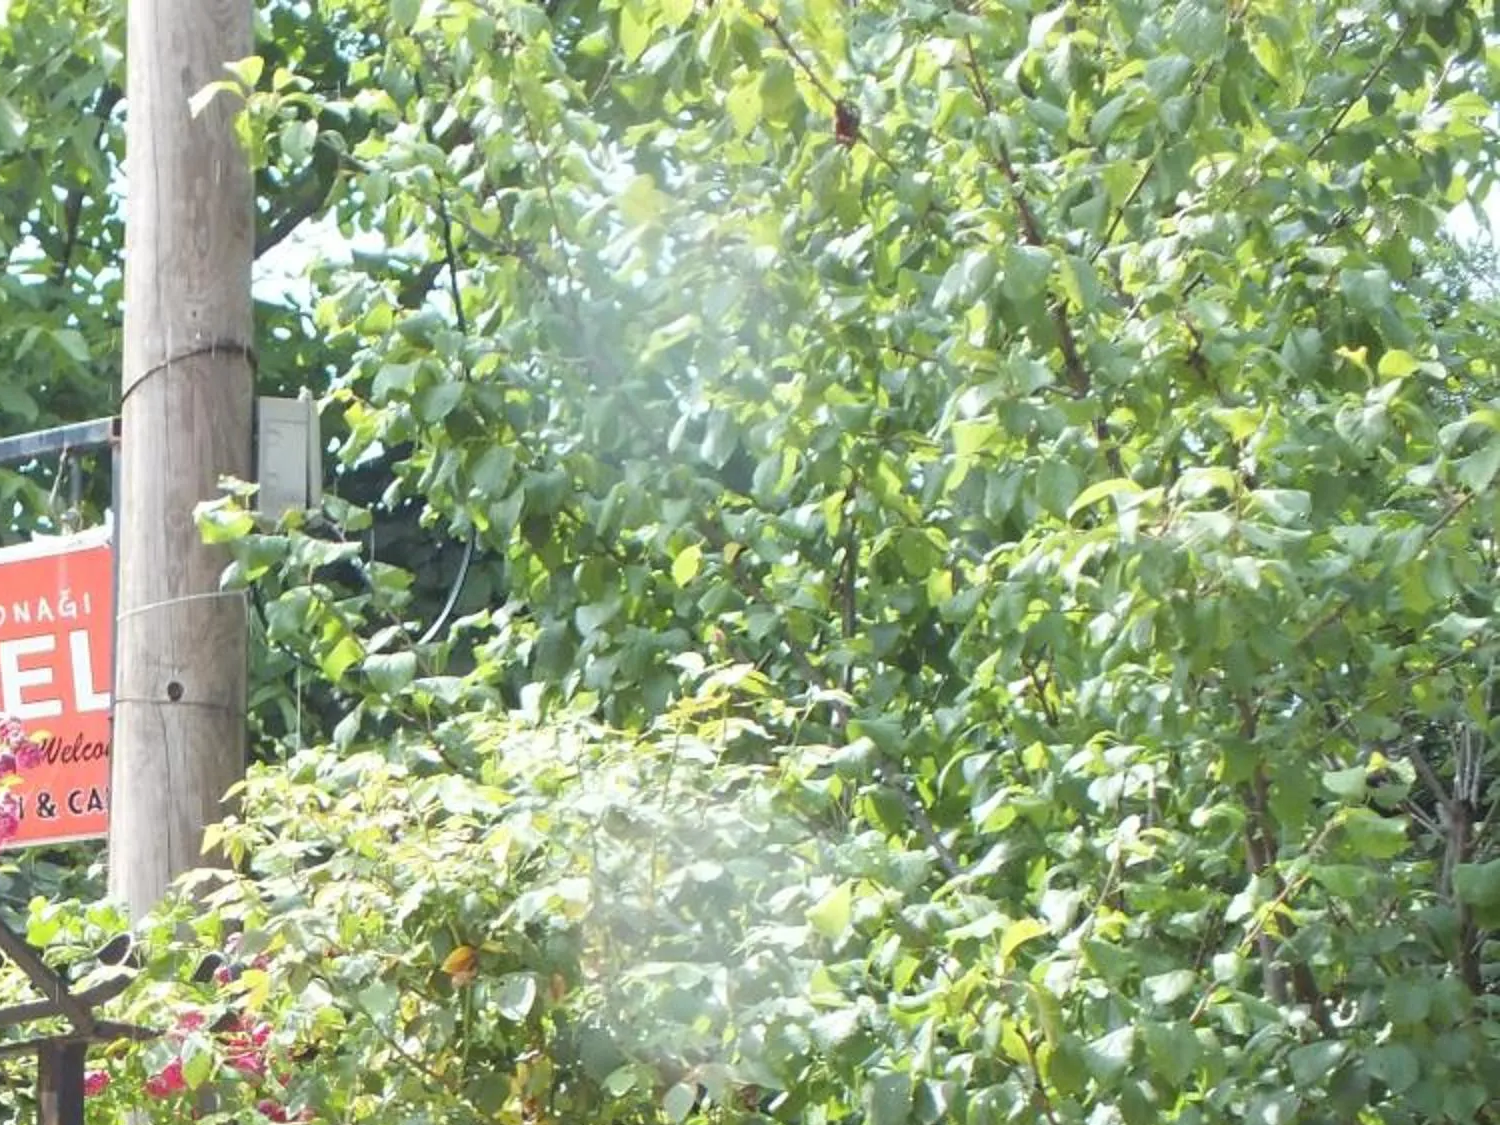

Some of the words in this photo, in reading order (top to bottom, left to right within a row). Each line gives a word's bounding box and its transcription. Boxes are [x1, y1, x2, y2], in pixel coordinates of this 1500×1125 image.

[40, 731, 112, 765] Welco
[36, 792, 57, 817] &
[68, 787, 109, 815] CA
